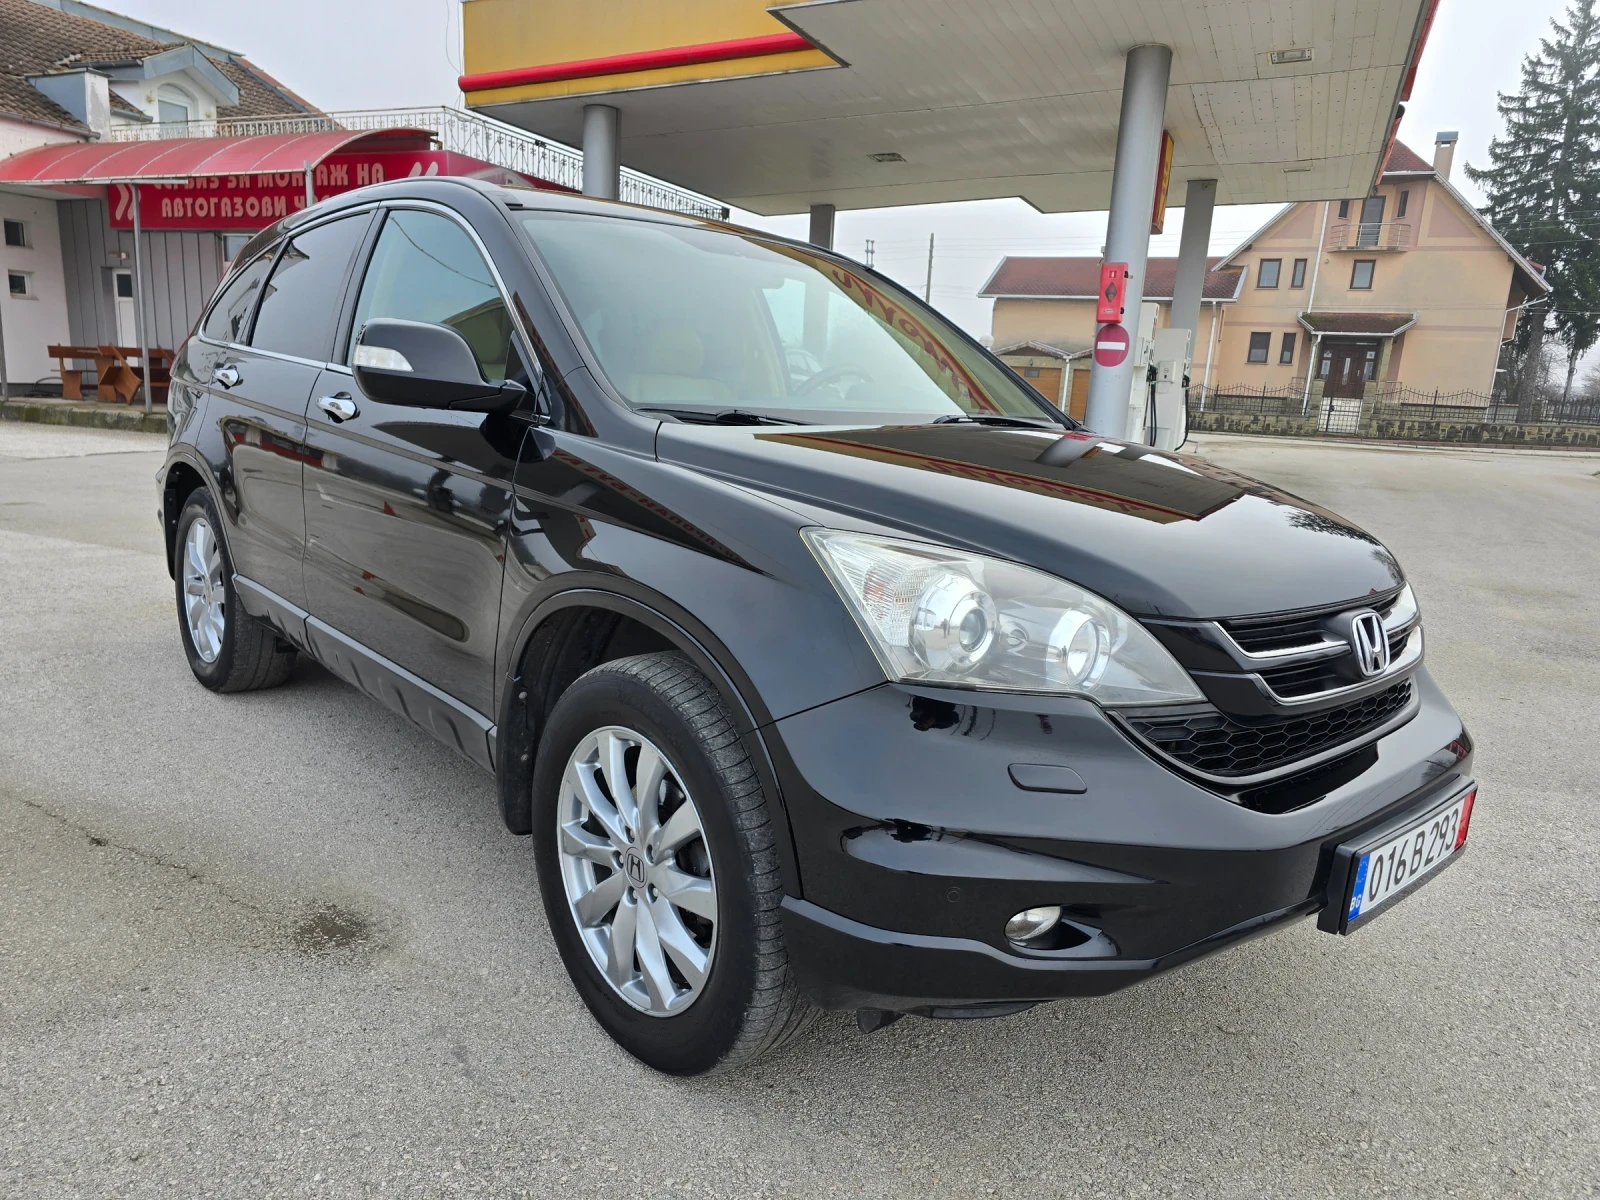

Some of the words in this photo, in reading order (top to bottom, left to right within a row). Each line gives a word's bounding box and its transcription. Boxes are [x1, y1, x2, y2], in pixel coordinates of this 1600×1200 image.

[258, 164, 349, 188] МОНАЖ
[357, 163, 384, 186] НА
[161, 195, 288, 218] АВТОГАЗОВИ
[1368, 807, 1459, 903] 016B293
[1350, 893, 1362, 912] BG
